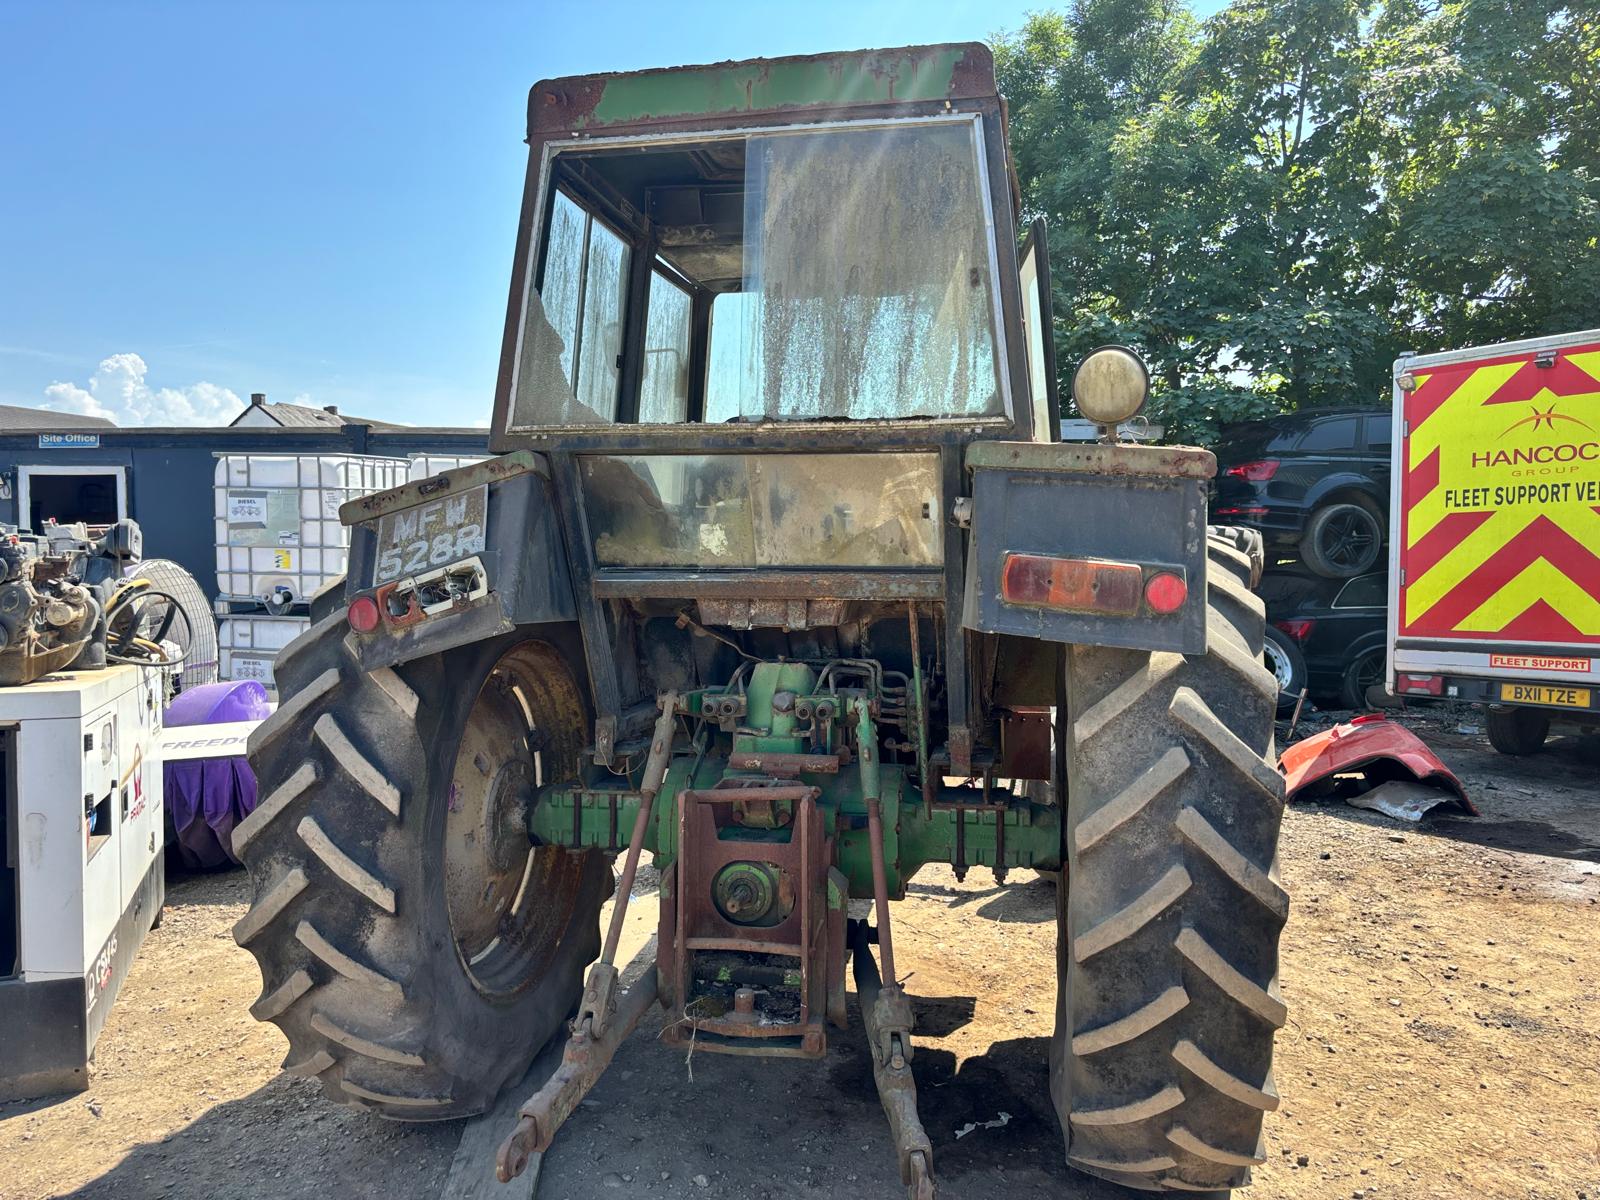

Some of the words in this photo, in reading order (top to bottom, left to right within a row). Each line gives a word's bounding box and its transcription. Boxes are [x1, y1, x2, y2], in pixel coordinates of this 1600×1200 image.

[42, 434, 63, 443] Site
[65, 434, 96, 443] Office
[1471, 442, 1600, 468] HANCOC
[1511, 466, 1580, 477] GROUP
[1445, 487, 1490, 508] FLEET
[1494, 482, 1571, 506] SUPPORT
[1575, 480, 1600, 501] VE
[393, 495, 467, 543] MFW
[378, 523, 485, 580] 528R
[1493, 657, 1529, 667] FLEET
[1531, 658, 1587, 670] SUPPORT
[1513, 686, 1542, 702] BX11
[1546, 689, 1577, 704] TZE
